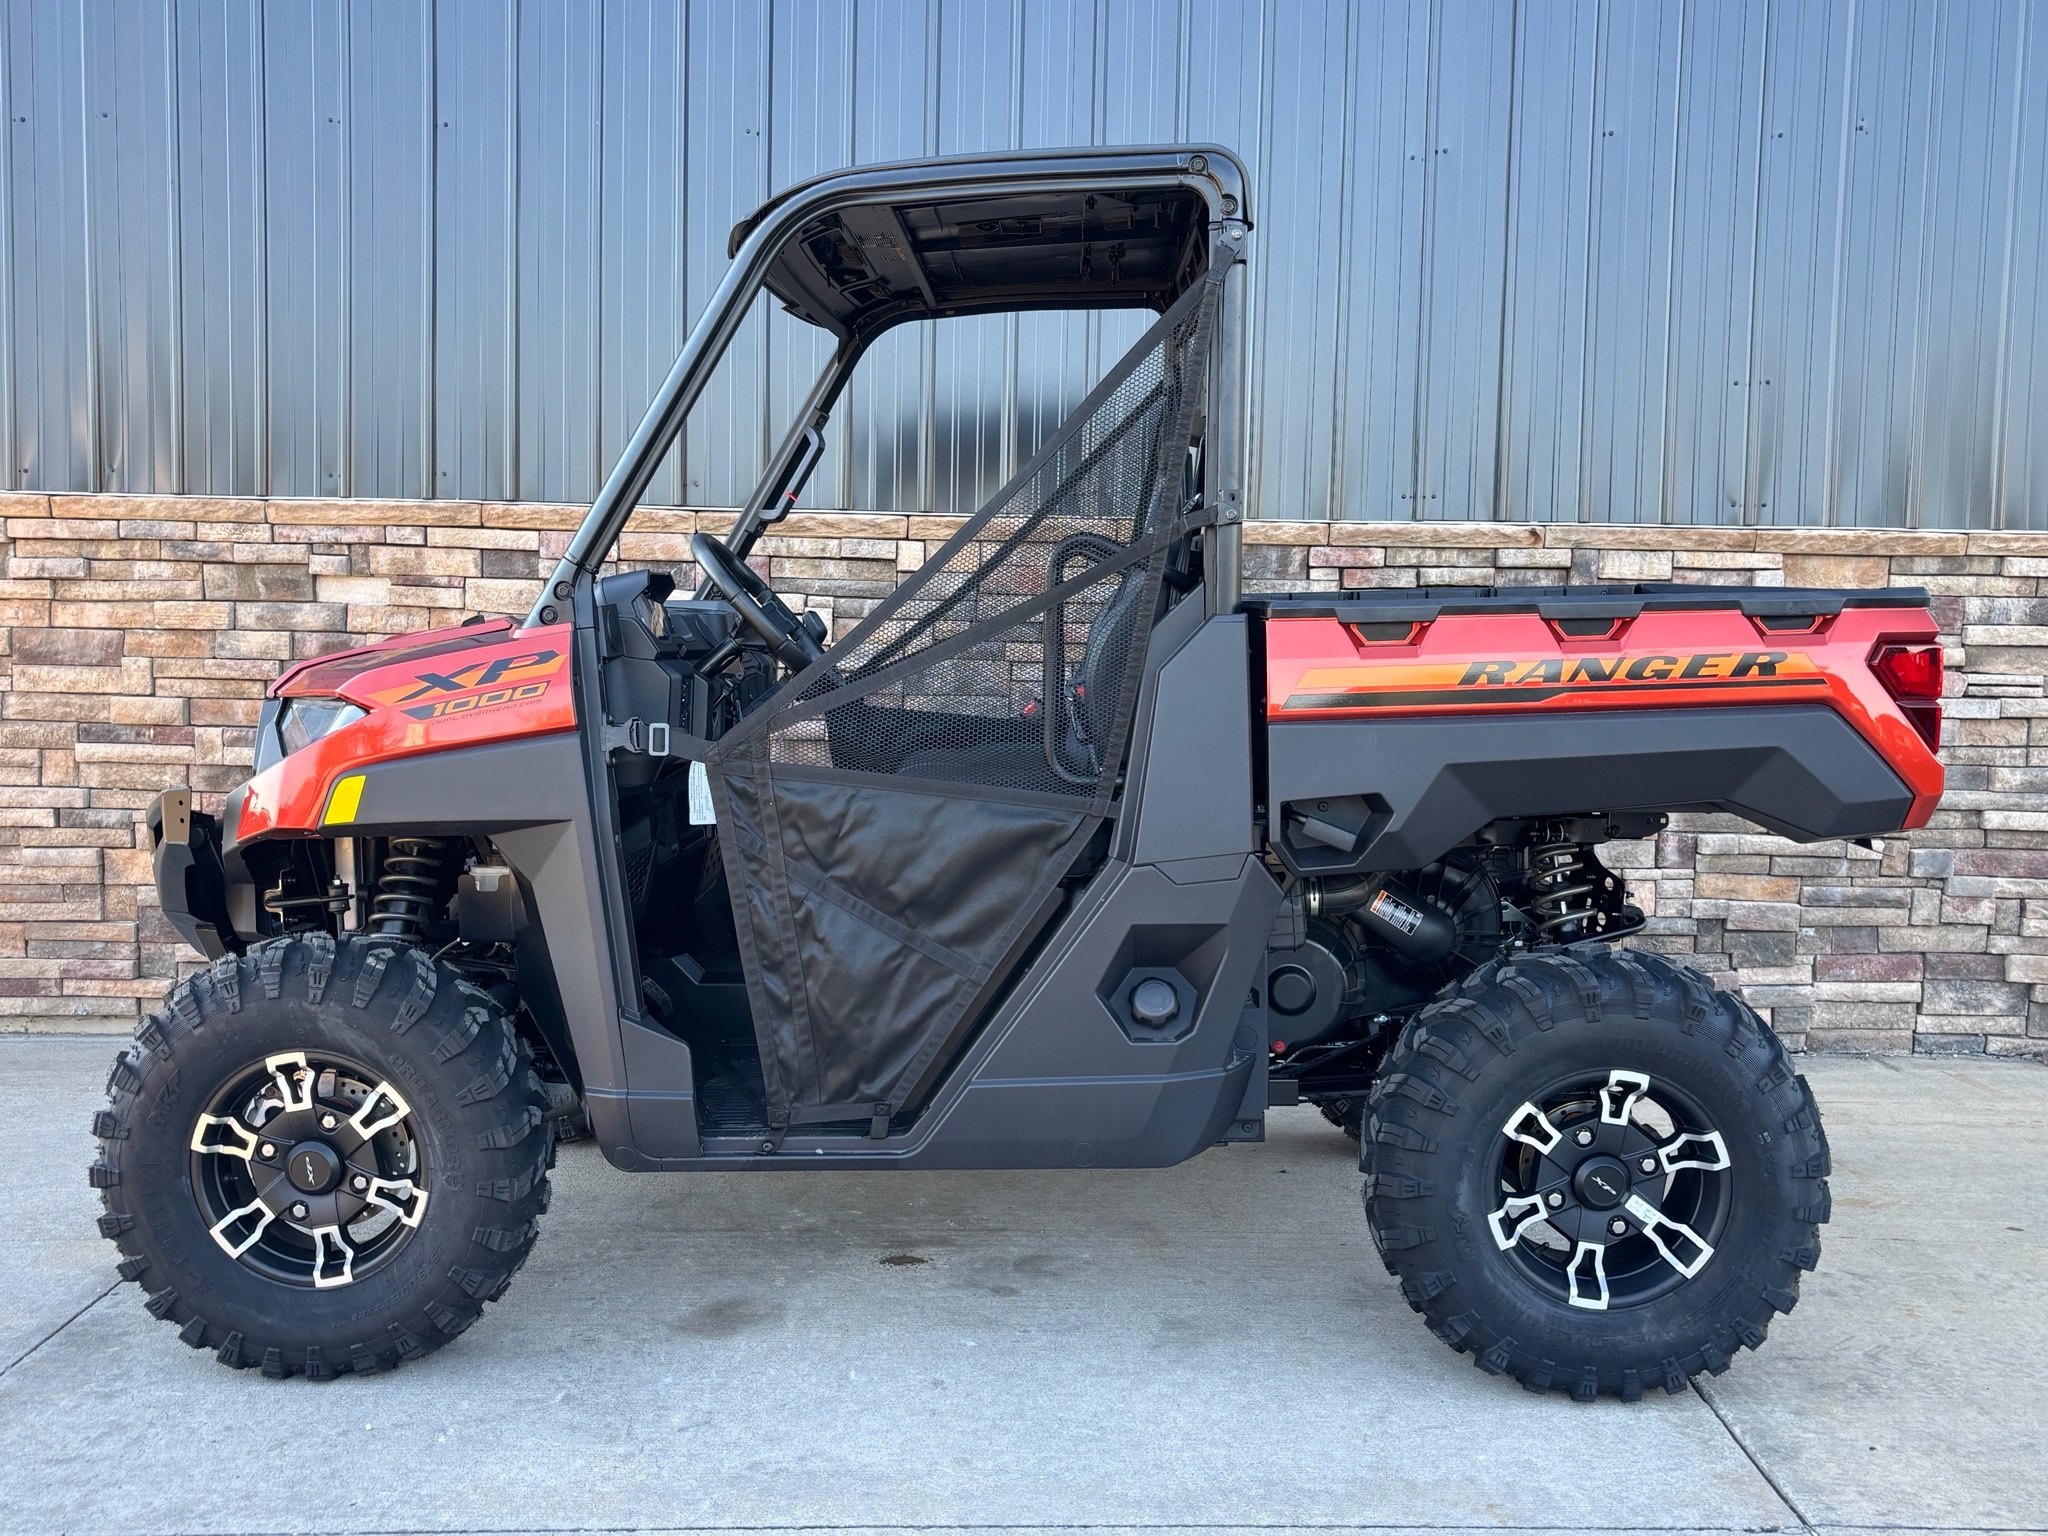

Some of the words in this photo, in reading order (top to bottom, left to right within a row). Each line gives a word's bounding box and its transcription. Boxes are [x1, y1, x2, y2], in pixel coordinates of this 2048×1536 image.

[393, 649, 561, 704] XP
[1457, 651, 1789, 687] RANGER
[431, 716, 458, 726] DUAL
[461, 703, 518, 719] OVERHEAD
[518, 698, 543, 708] CAM
[432, 682, 547, 718] 1000
[387, 1050, 427, 1091] PRO
[423, 1091, 463, 1170] ARMOR
[305, 1156, 315, 1186] XP
[1591, 1176, 1617, 1196] XP
